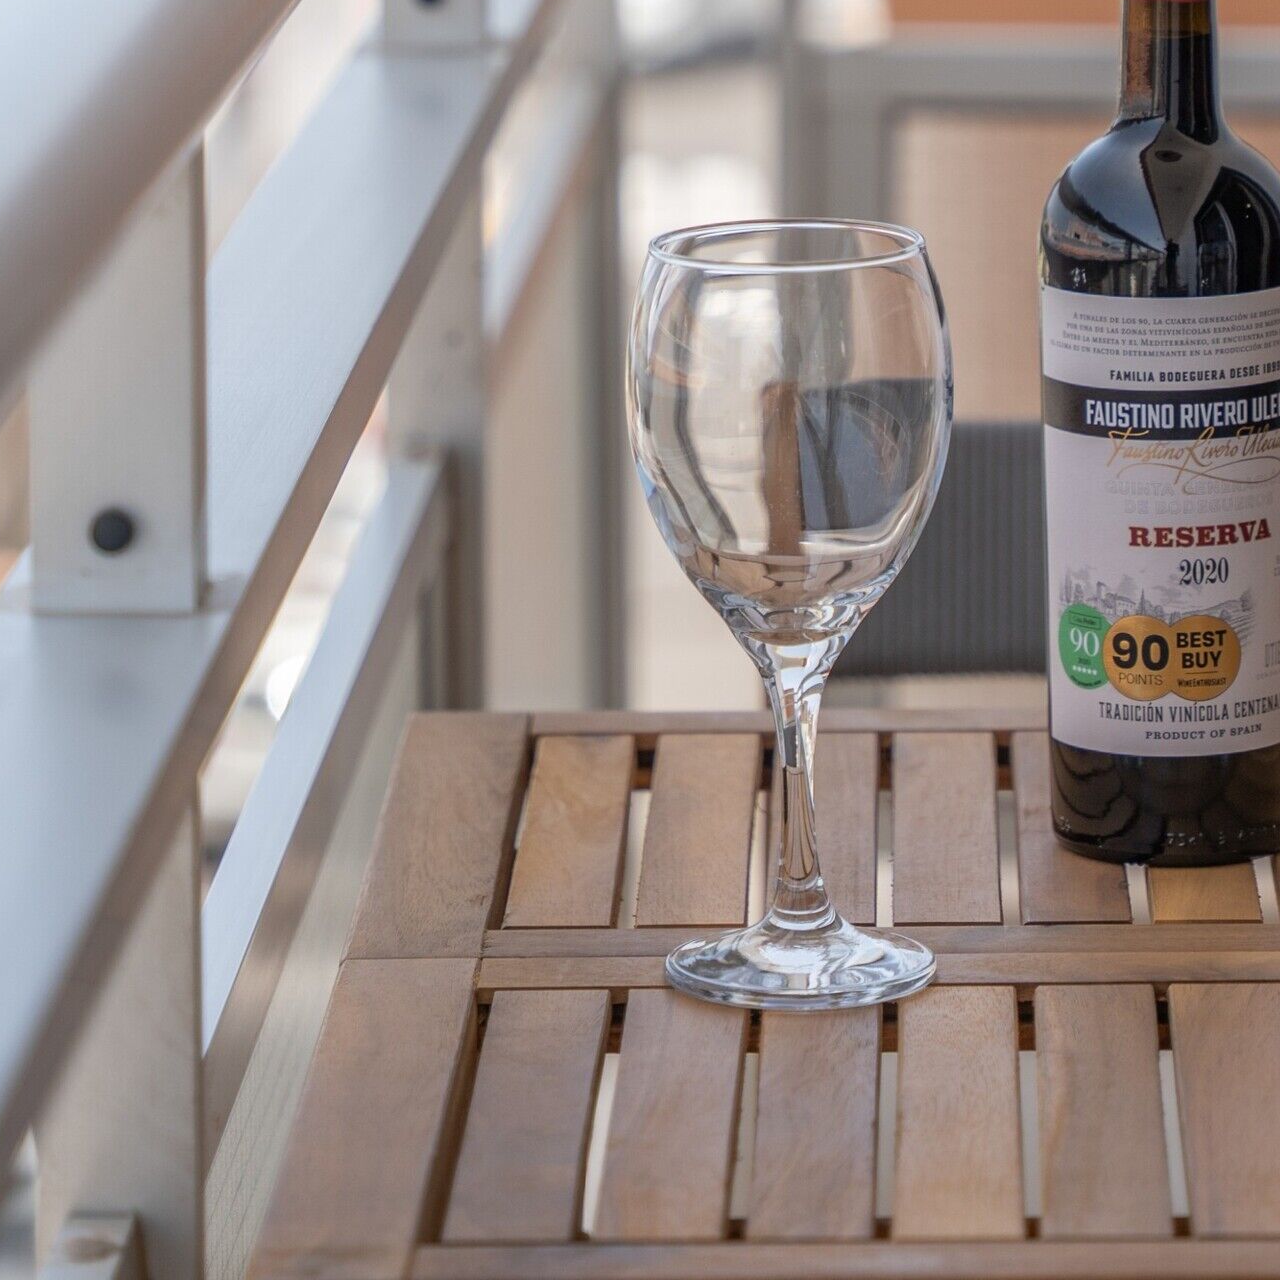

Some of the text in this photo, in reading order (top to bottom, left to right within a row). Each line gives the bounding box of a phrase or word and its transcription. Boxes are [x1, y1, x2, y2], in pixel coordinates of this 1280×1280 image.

[1109, 316, 1119, 324] DE
[1121, 317, 1137, 325] LOS
[1121, 328, 1147, 336] ZONAS
[1093, 346, 1120, 356] FACTOR
[1122, 349, 1187, 358] DETERMINANTE
[1189, 349, 1201, 358] EN
[1203, 349, 1213, 357] LA
[1109, 369, 1155, 382] FAMILIA
[1159, 369, 1226, 383] BODEGUERA
[1229, 364, 1261, 380] DESDE
[1085, 399, 1176, 430] FAUSTINO
[1180, 399, 1249, 429] RIVERO
[1128, 518, 1272, 548] RESERVA
[1178, 557, 1229, 586] 2020
[1070, 627, 1100, 657] 90
[1176, 629, 1227, 648] BEST
[1111, 632, 1170, 671] 90
[1181, 650, 1222, 669] BUY
[1119, 672, 1164, 686] POINTS
[1099, 701, 1163, 723] TRADICIÓN
[1168, 701, 1229, 723] VINÍCOLA
[1145, 723, 1262, 740] PRODUCT OF SPAIN
